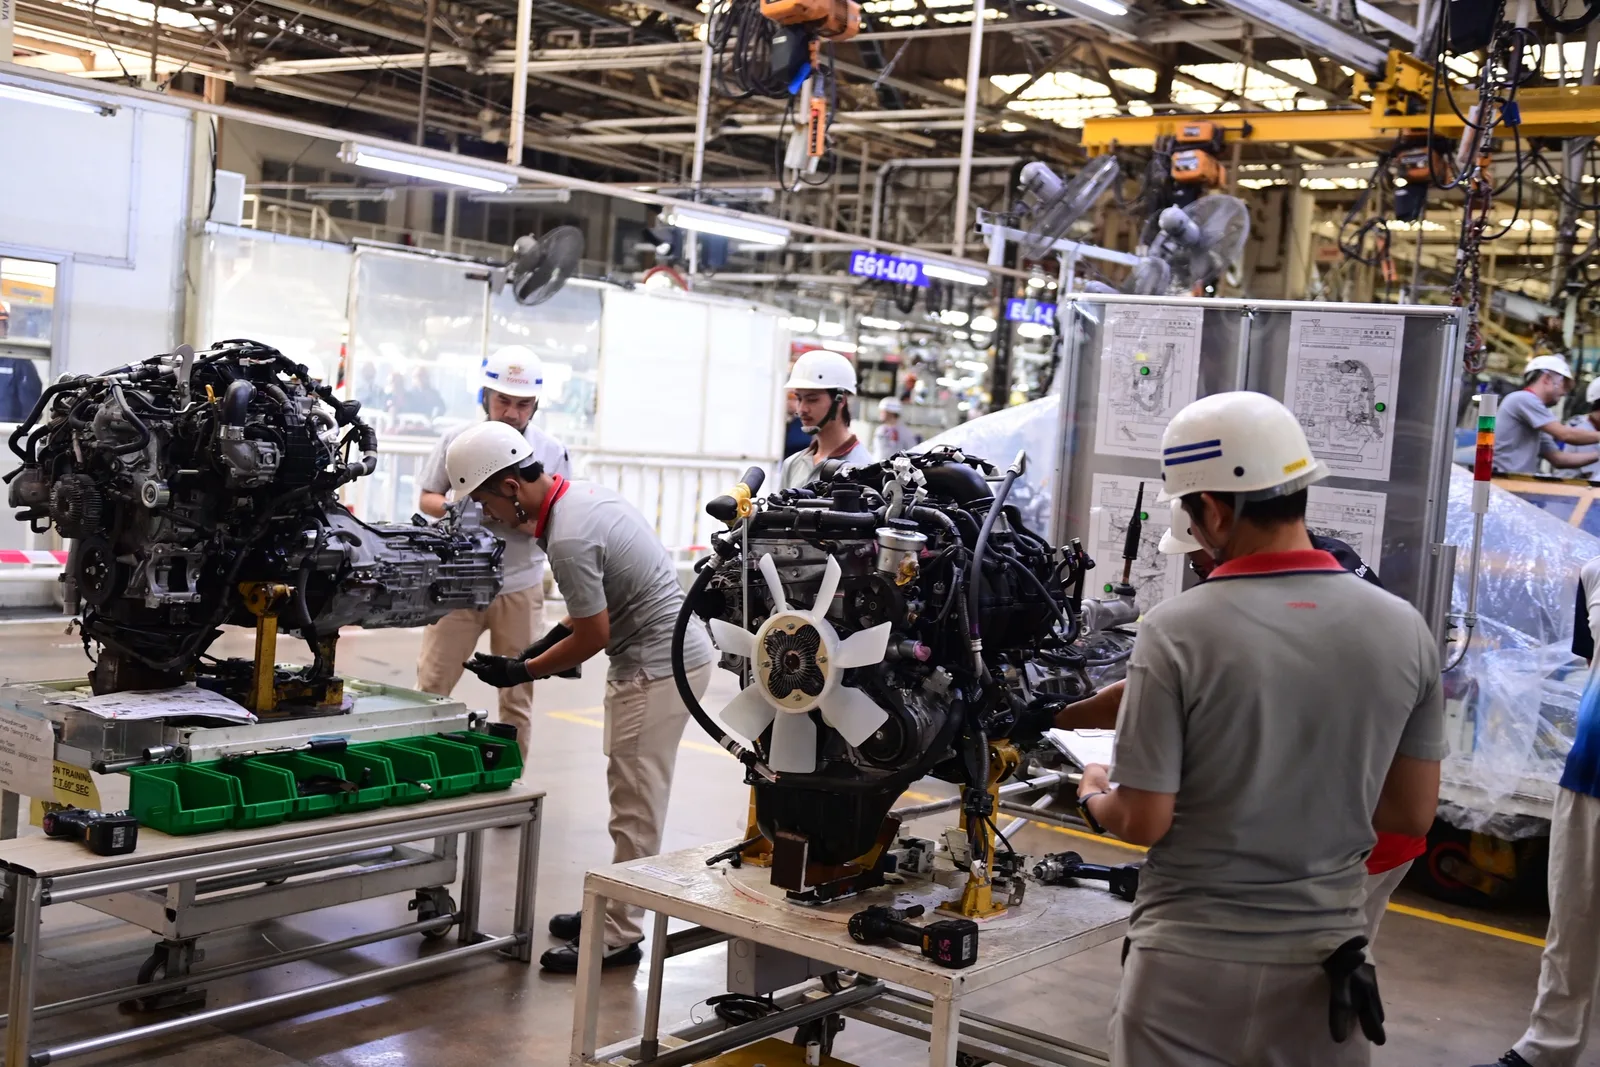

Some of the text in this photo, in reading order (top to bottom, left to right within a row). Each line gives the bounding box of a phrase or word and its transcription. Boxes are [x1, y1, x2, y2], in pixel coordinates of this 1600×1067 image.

[853, 254, 918, 283] EG1-L00
[62, 767, 91, 783] TRAINING
[75, 783, 89, 795] SEC
